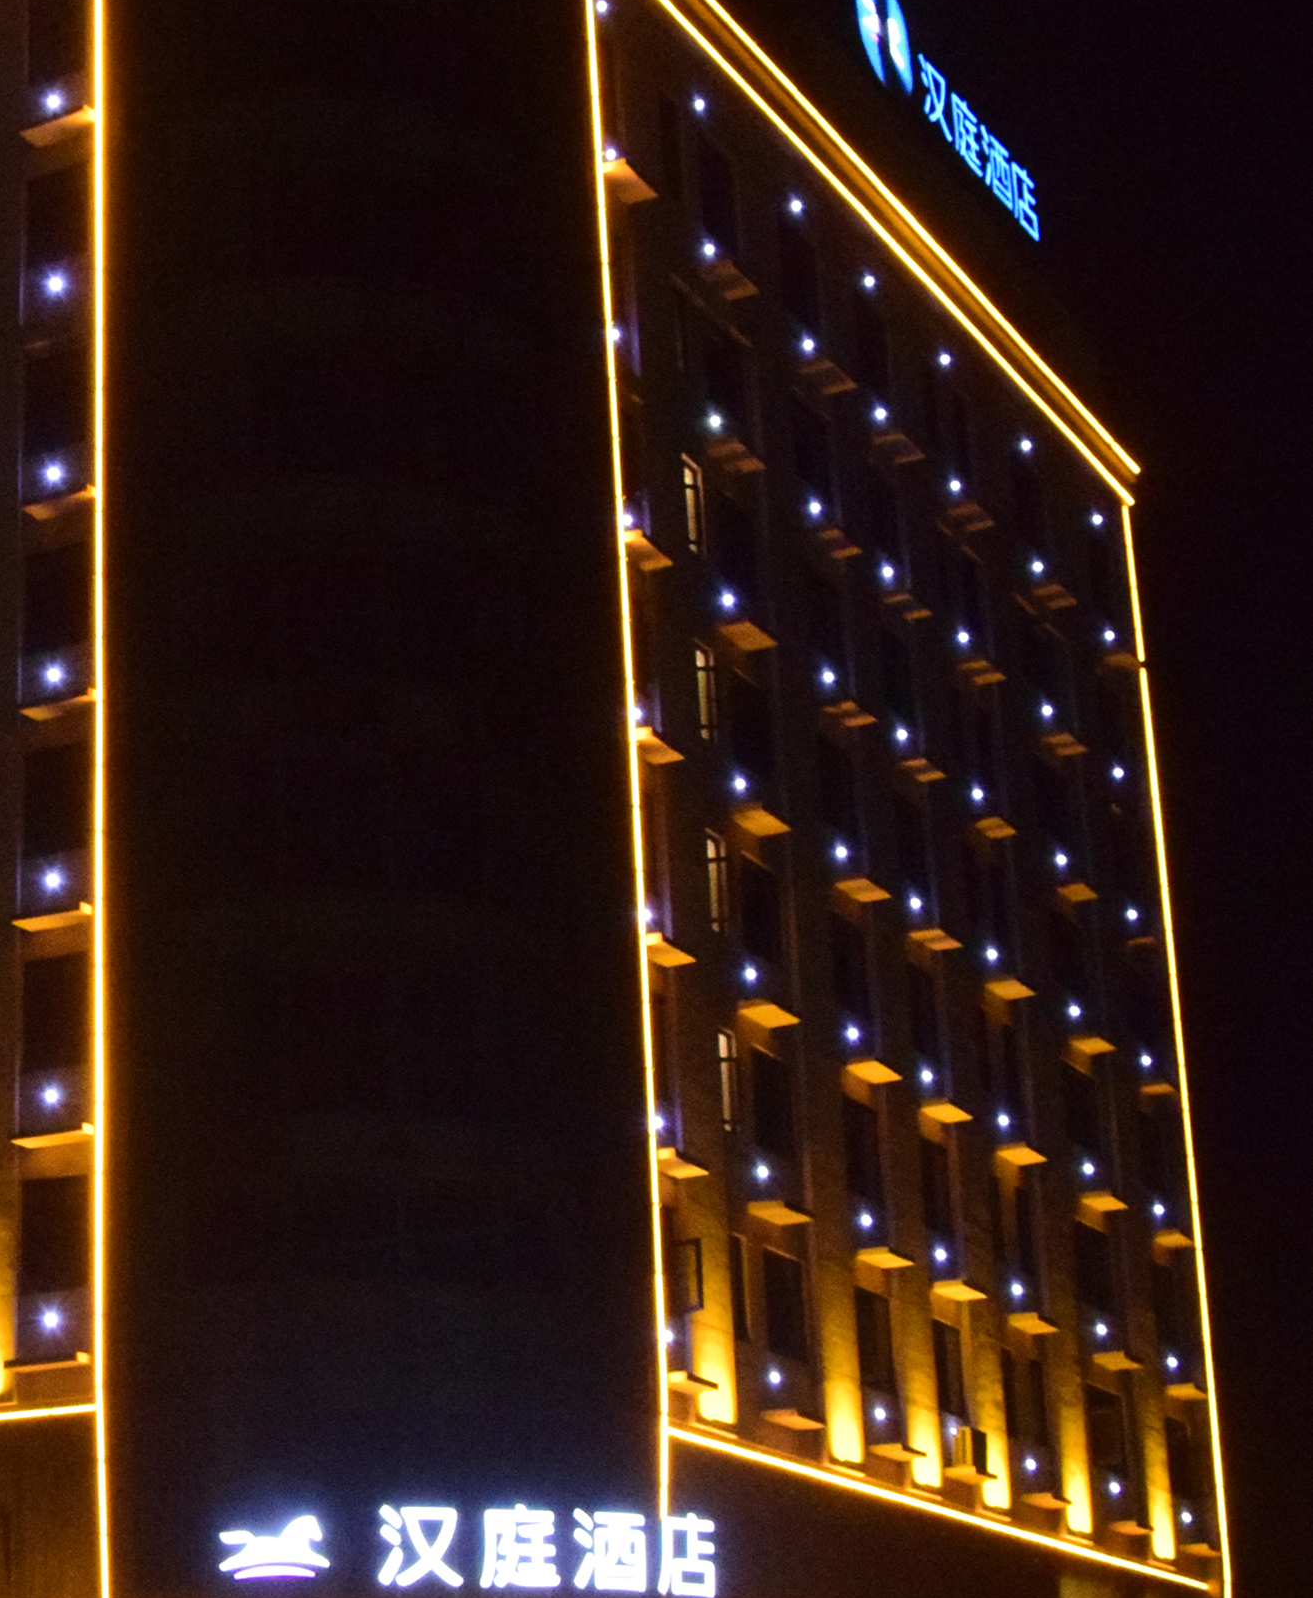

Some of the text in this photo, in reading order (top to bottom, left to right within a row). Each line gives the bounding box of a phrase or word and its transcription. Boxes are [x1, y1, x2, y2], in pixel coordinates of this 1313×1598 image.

[917, 53, 1040, 241] 汉庭酒店
[378, 1503, 716, 1598] 汉庭酒店
